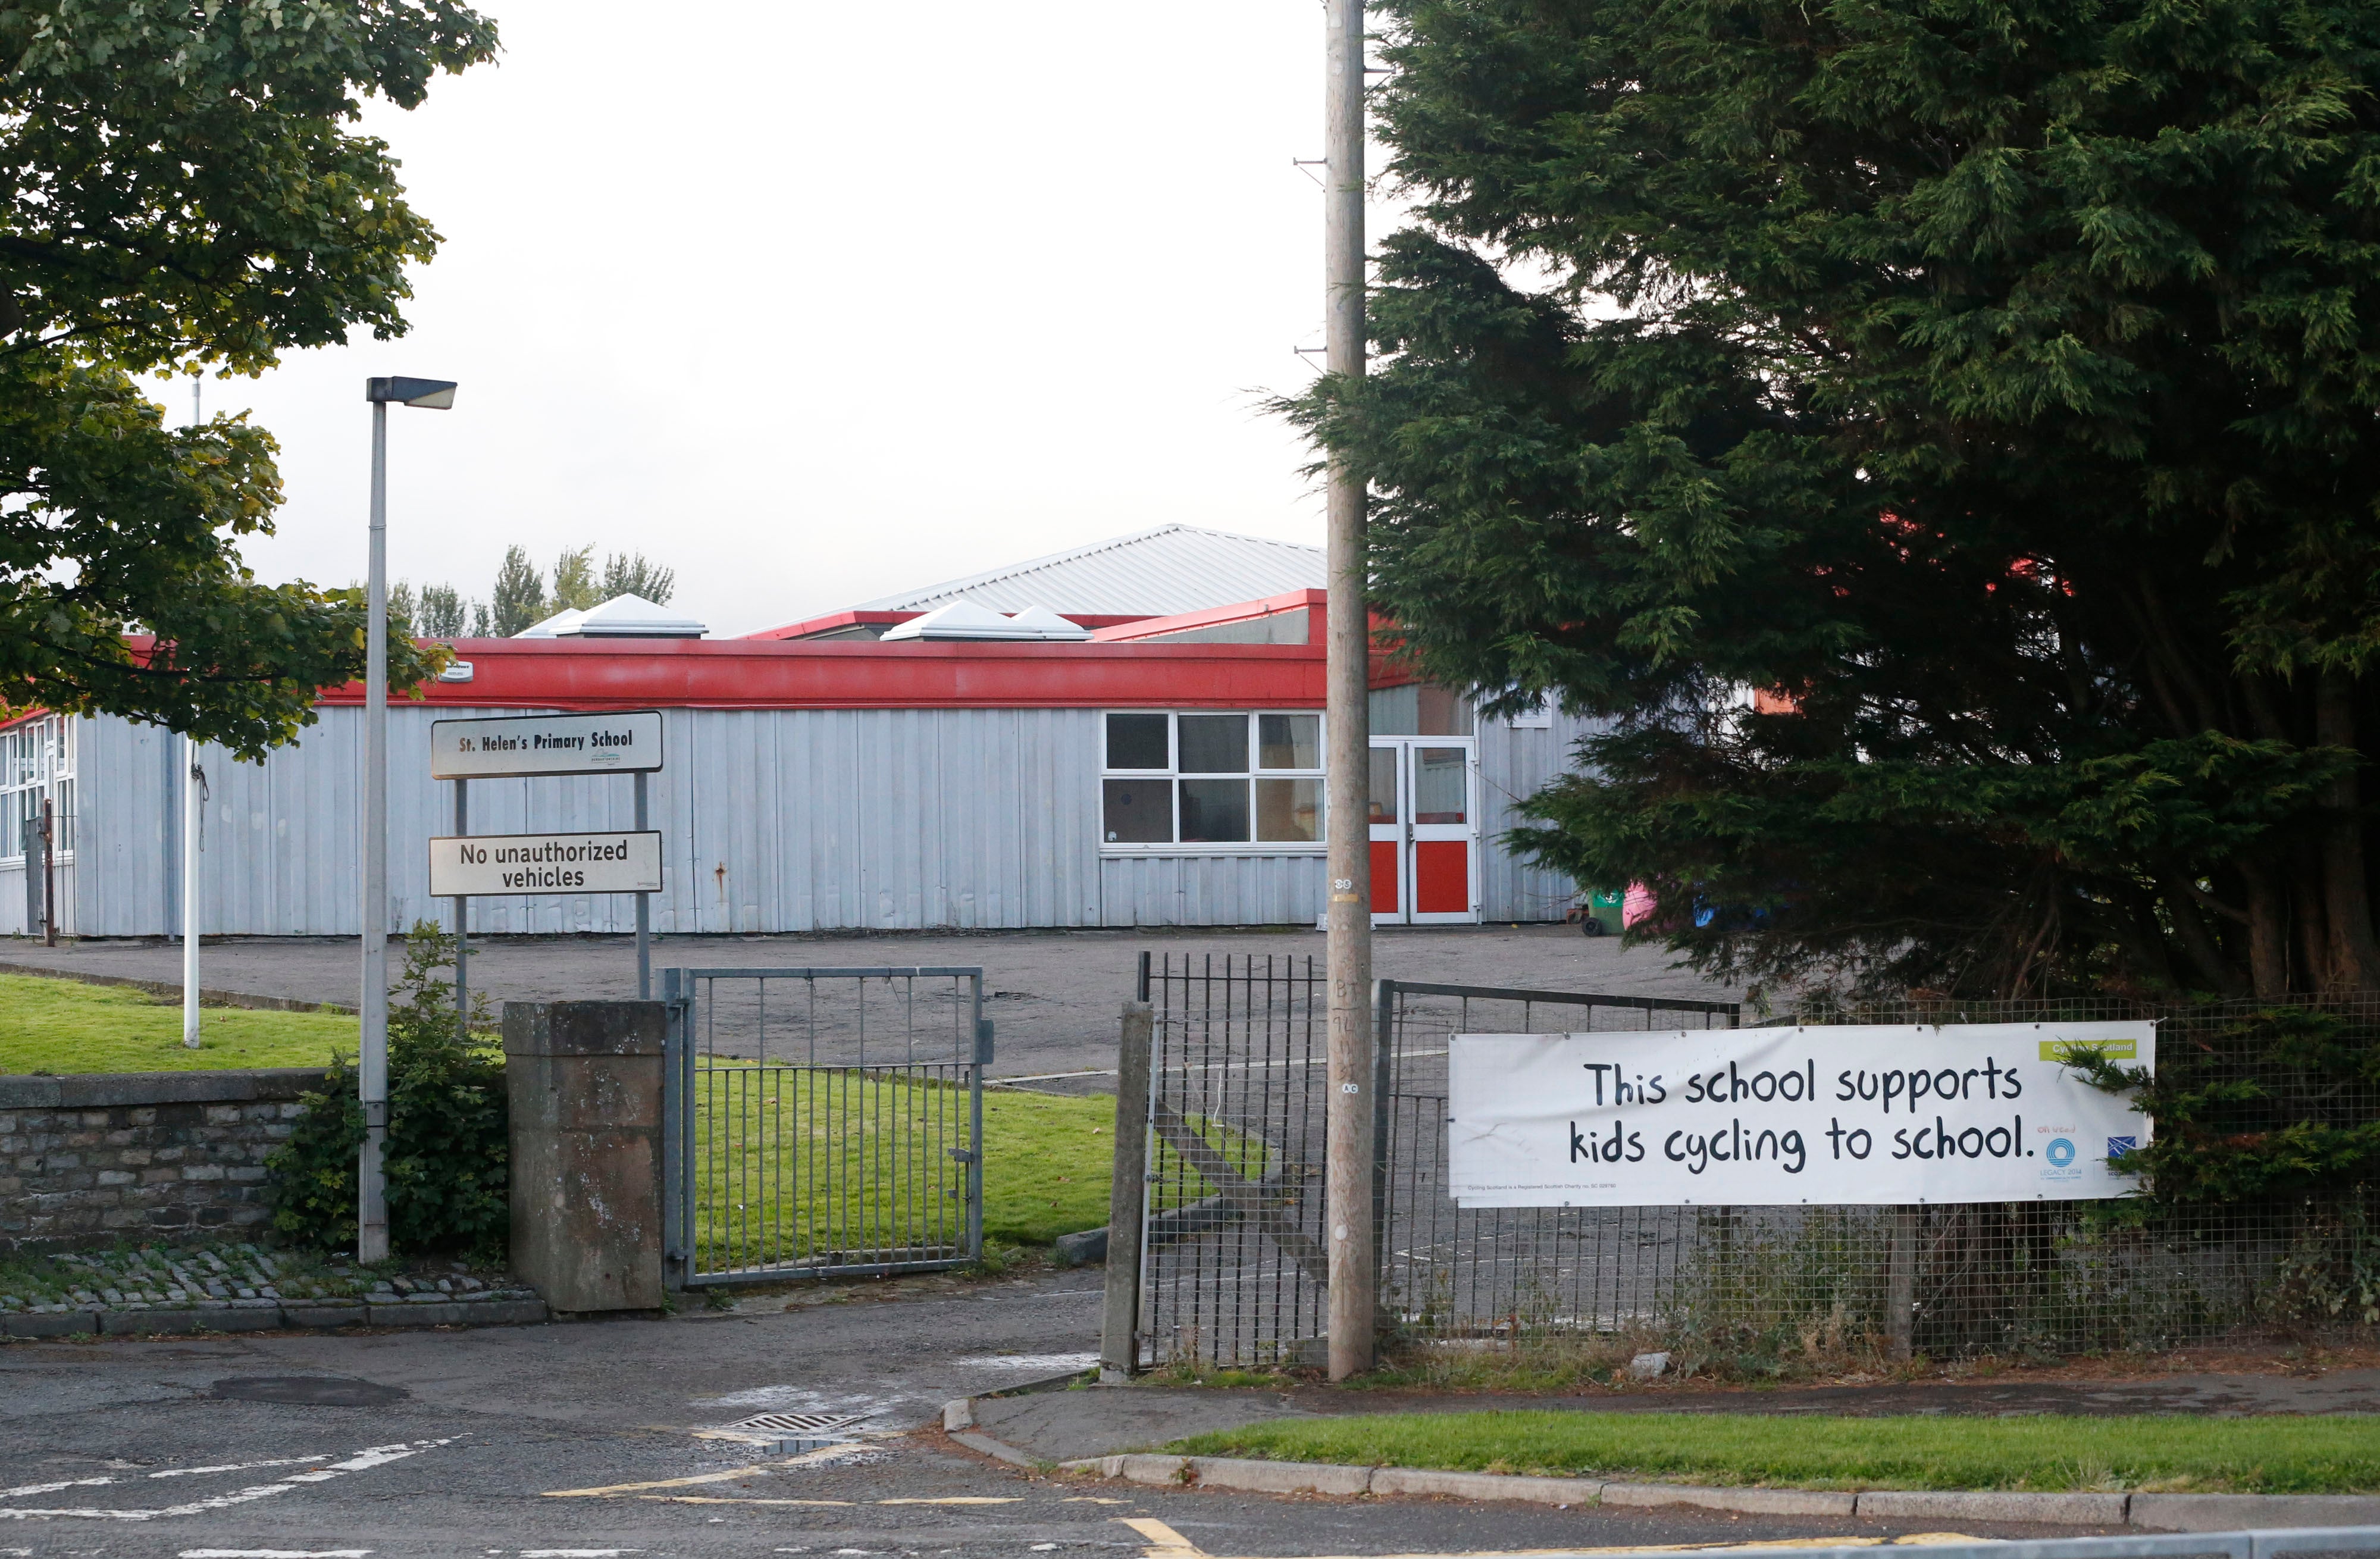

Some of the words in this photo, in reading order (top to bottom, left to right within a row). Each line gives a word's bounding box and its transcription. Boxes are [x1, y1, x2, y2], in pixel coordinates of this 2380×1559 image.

[459, 737, 475, 752] St.
[482, 735, 527, 752] Helen's
[534, 733, 585, 750] Primary
[591, 730, 632, 747] School
[461, 844, 487, 865] No
[495, 839, 628, 863] unauthorized
[502, 866, 585, 888] vehicles
[1583, 1063, 1667, 1106] This
[1685, 1058, 1814, 1103] school
[1836, 1056, 2022, 1113] supports
[1570, 1120, 1645, 1163] kids
[1664, 1118, 1806, 1175] cycling
[1825, 1117, 1872, 1160] to
[1892, 1115, 2034, 1160] school.
